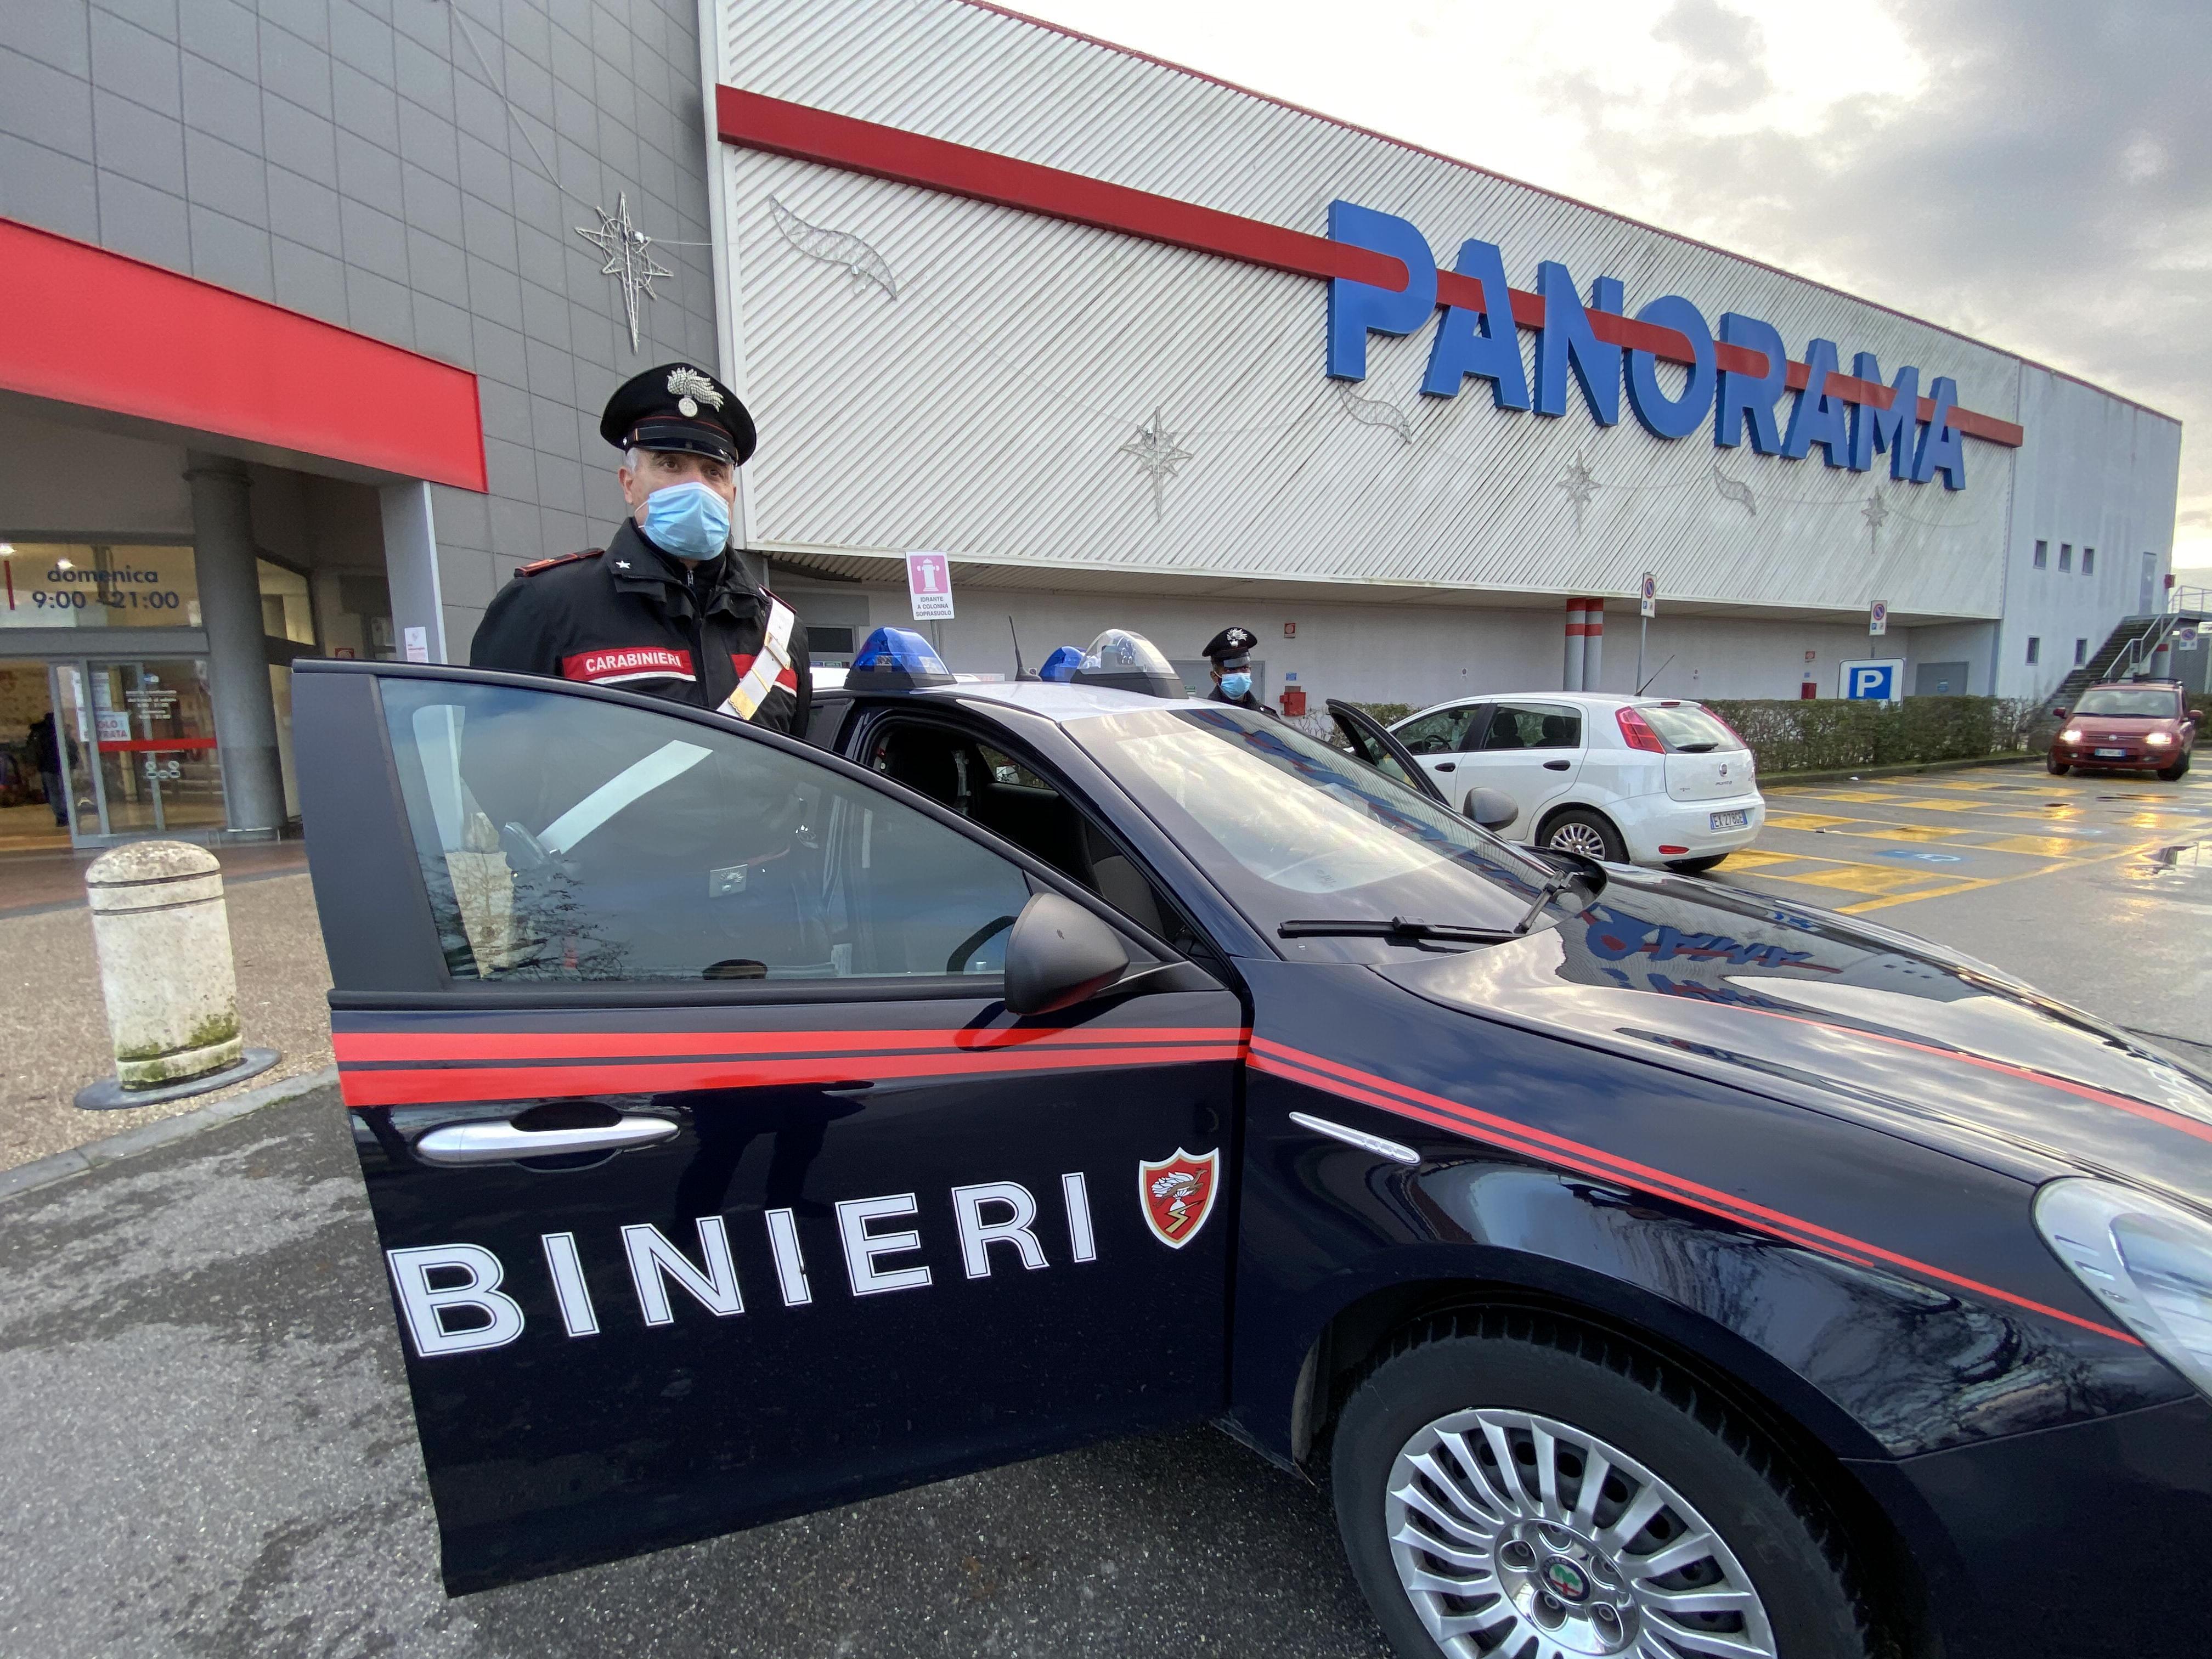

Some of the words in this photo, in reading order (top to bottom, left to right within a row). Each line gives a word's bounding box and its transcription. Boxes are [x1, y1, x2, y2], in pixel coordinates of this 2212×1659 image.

[1327, 199, 1966, 490] PANORAMA
[47, 562, 159, 583] domenica
[32, 591, 86, 608] 9:00
[111, 591, 179, 608] 21:00
[585, 652, 681, 673] CARABINIERI
[1857, 670, 1883, 698] P
[386, 1172, 1098, 1358] BINIERI
